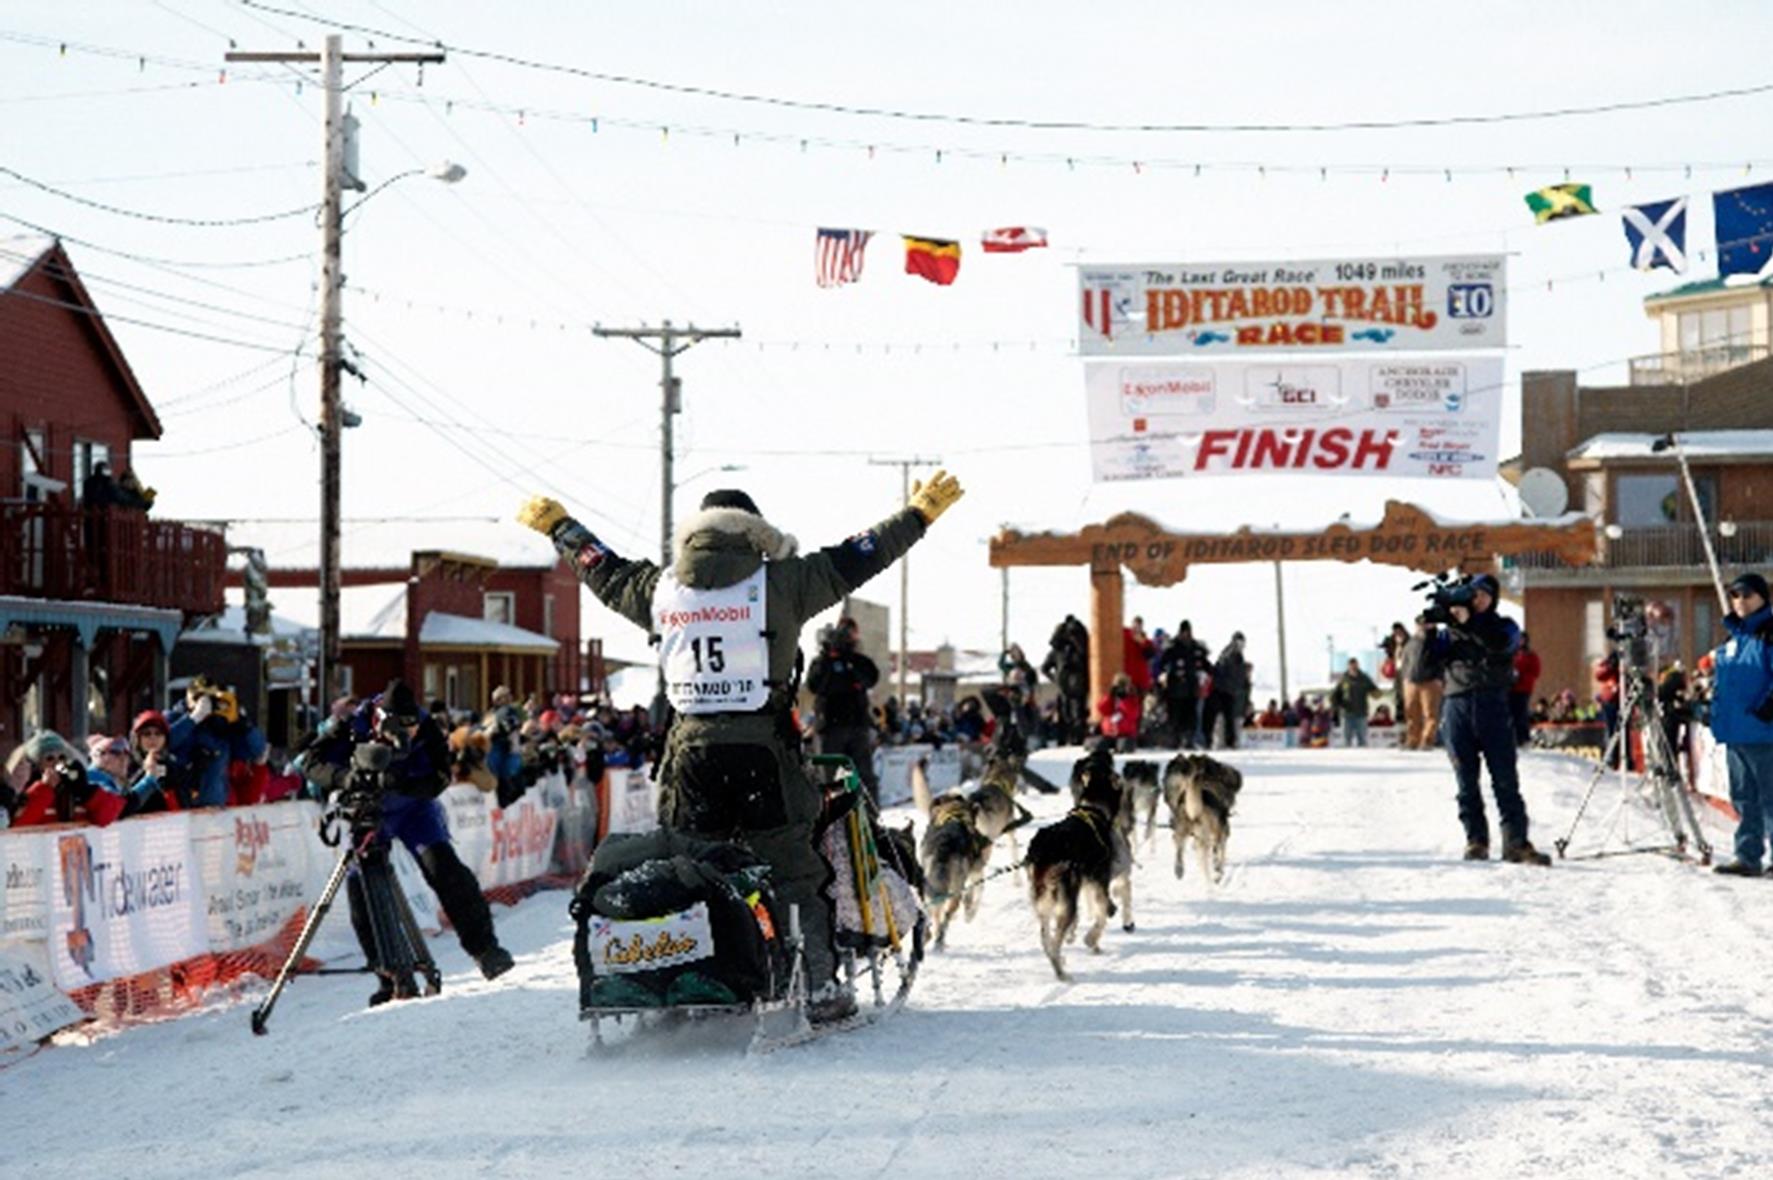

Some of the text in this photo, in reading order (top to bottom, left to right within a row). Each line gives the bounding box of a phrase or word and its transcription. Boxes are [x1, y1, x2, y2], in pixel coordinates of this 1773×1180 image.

[1181, 271, 1215, 284] Last
[1222, 269, 1267, 284] Great
[1335, 263, 1377, 281] 1049
[1381, 262, 1426, 280] miles
[1146, 283, 1438, 334] IDITAROD TRAIL
[1454, 287, 1492, 317] 10
[1236, 321, 1345, 346] RACE
[1193, 427, 1400, 471] FINISH
[1092, 531, 1487, 561] END OF IDITAROD SLED DOG RACE
[691, 636, 726, 673] 15
[93, 861, 184, 919] Tidewater
